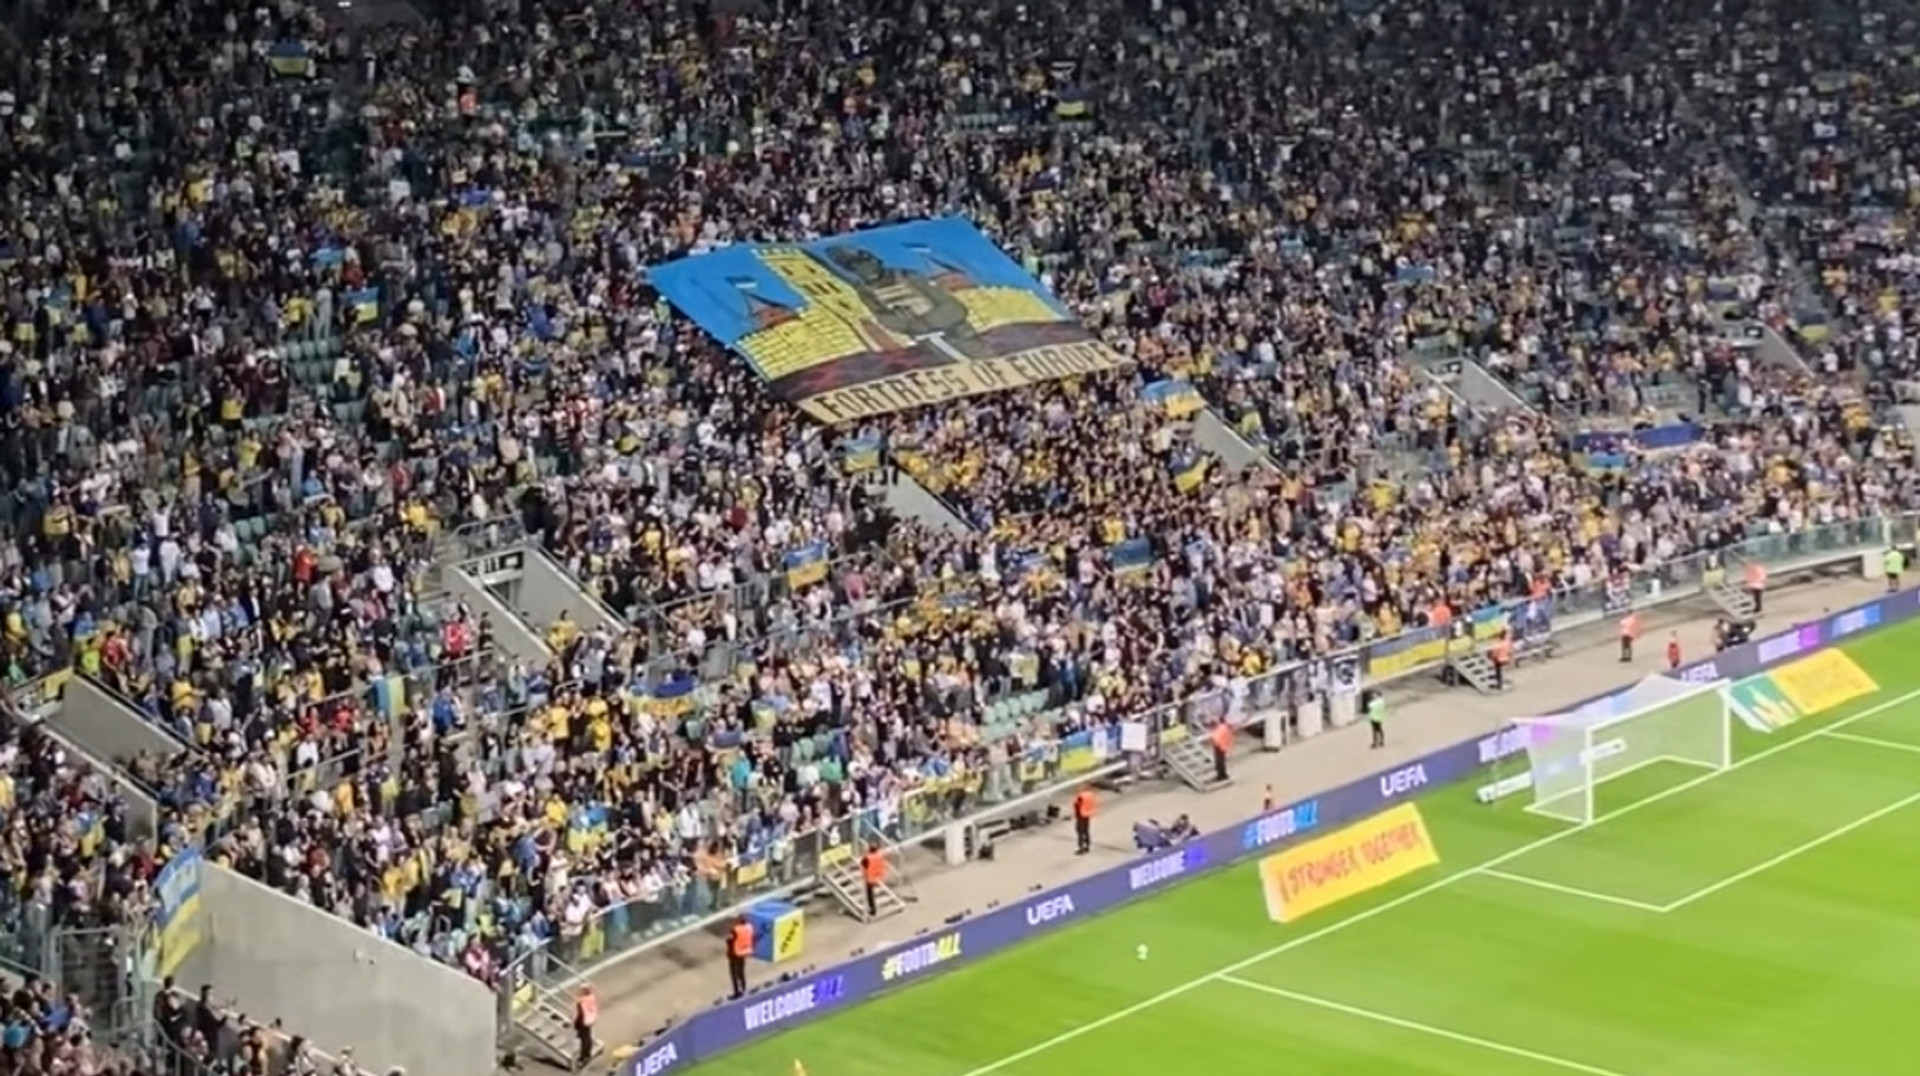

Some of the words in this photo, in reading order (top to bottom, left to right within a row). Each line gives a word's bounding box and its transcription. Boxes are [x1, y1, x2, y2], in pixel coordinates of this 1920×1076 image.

[813, 369, 970, 419] FORTRESS
[969, 359, 1009, 388] OF
[1004, 342, 1120, 382] EUROPE
[1380, 764, 1428, 797] UEFA
[1027, 894, 1075, 925] UEFA
[744, 984, 816, 1030] WELCOME
[635, 1041, 678, 1076] UEFA
